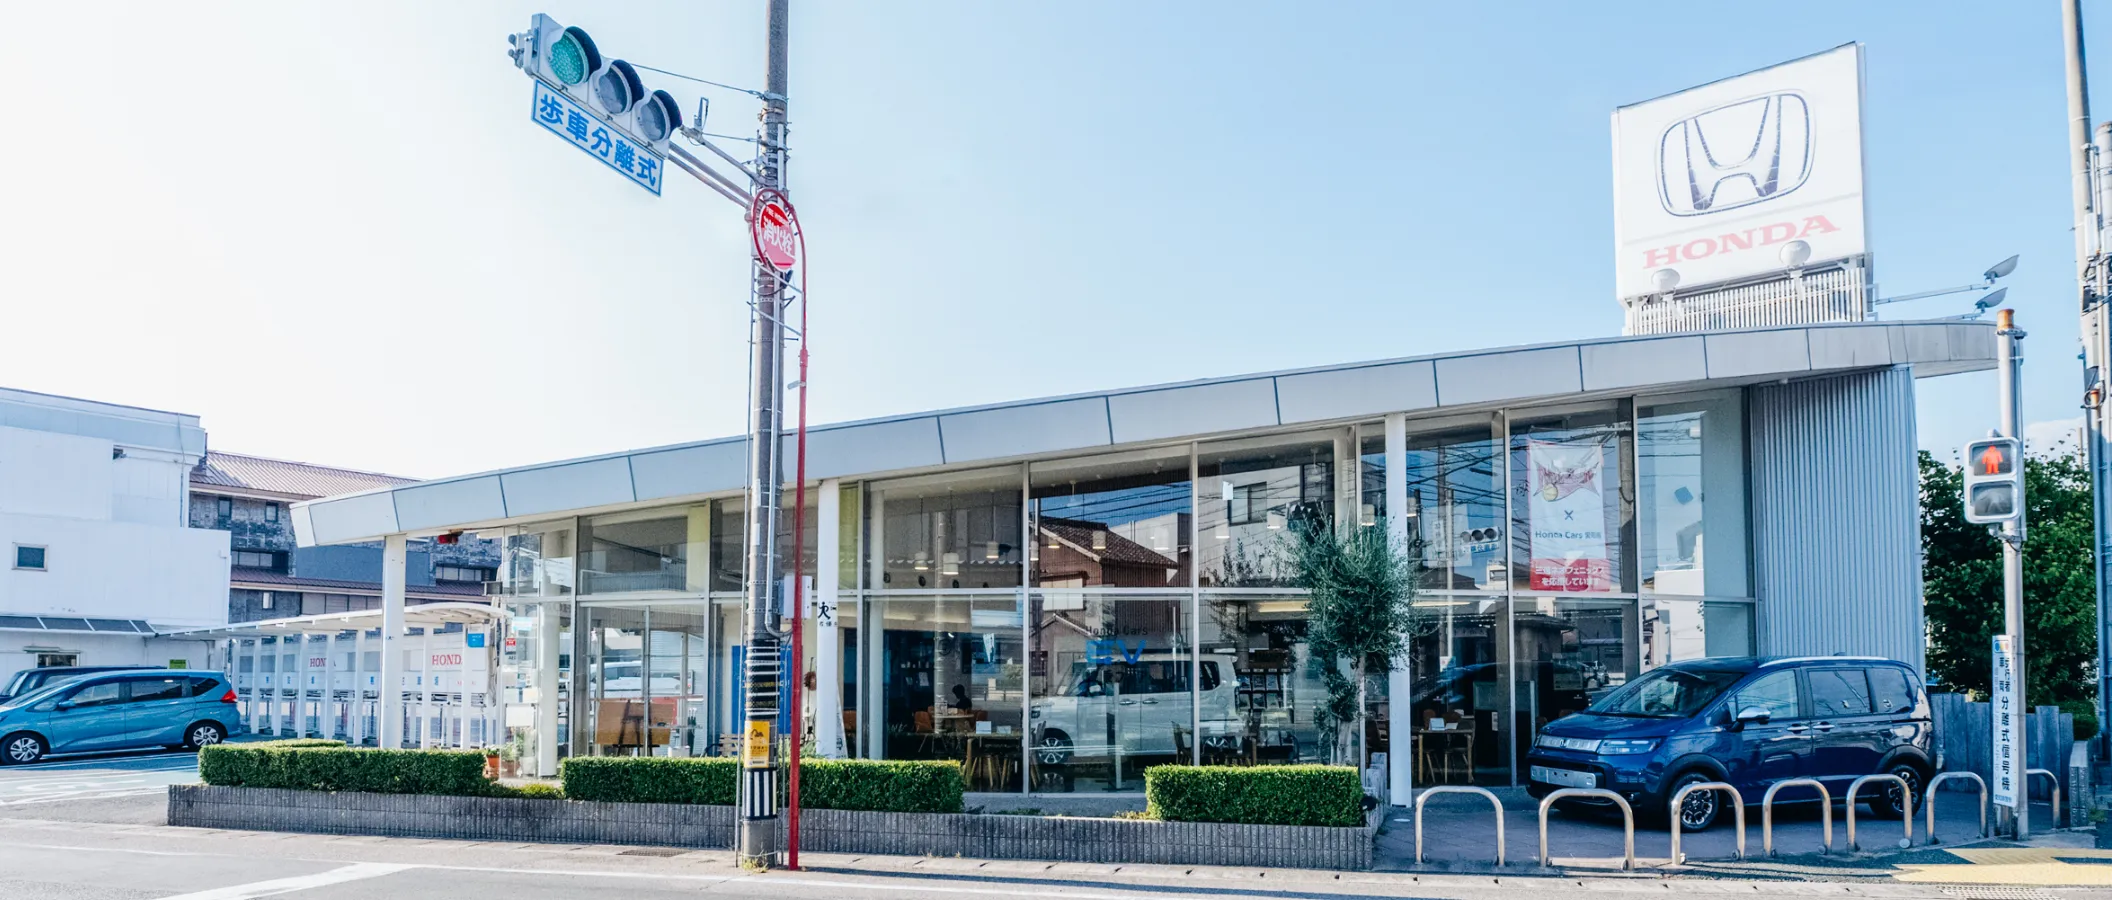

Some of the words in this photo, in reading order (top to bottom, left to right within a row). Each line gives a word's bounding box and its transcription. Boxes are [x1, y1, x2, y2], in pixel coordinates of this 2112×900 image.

[540, 94, 657, 186] 歩車分離式
[1643, 214, 1840, 269] HONDA
[1565, 531, 1582, 539] Cars
[431, 654, 462, 666] HOND
[1086, 640, 1146, 665] EV
